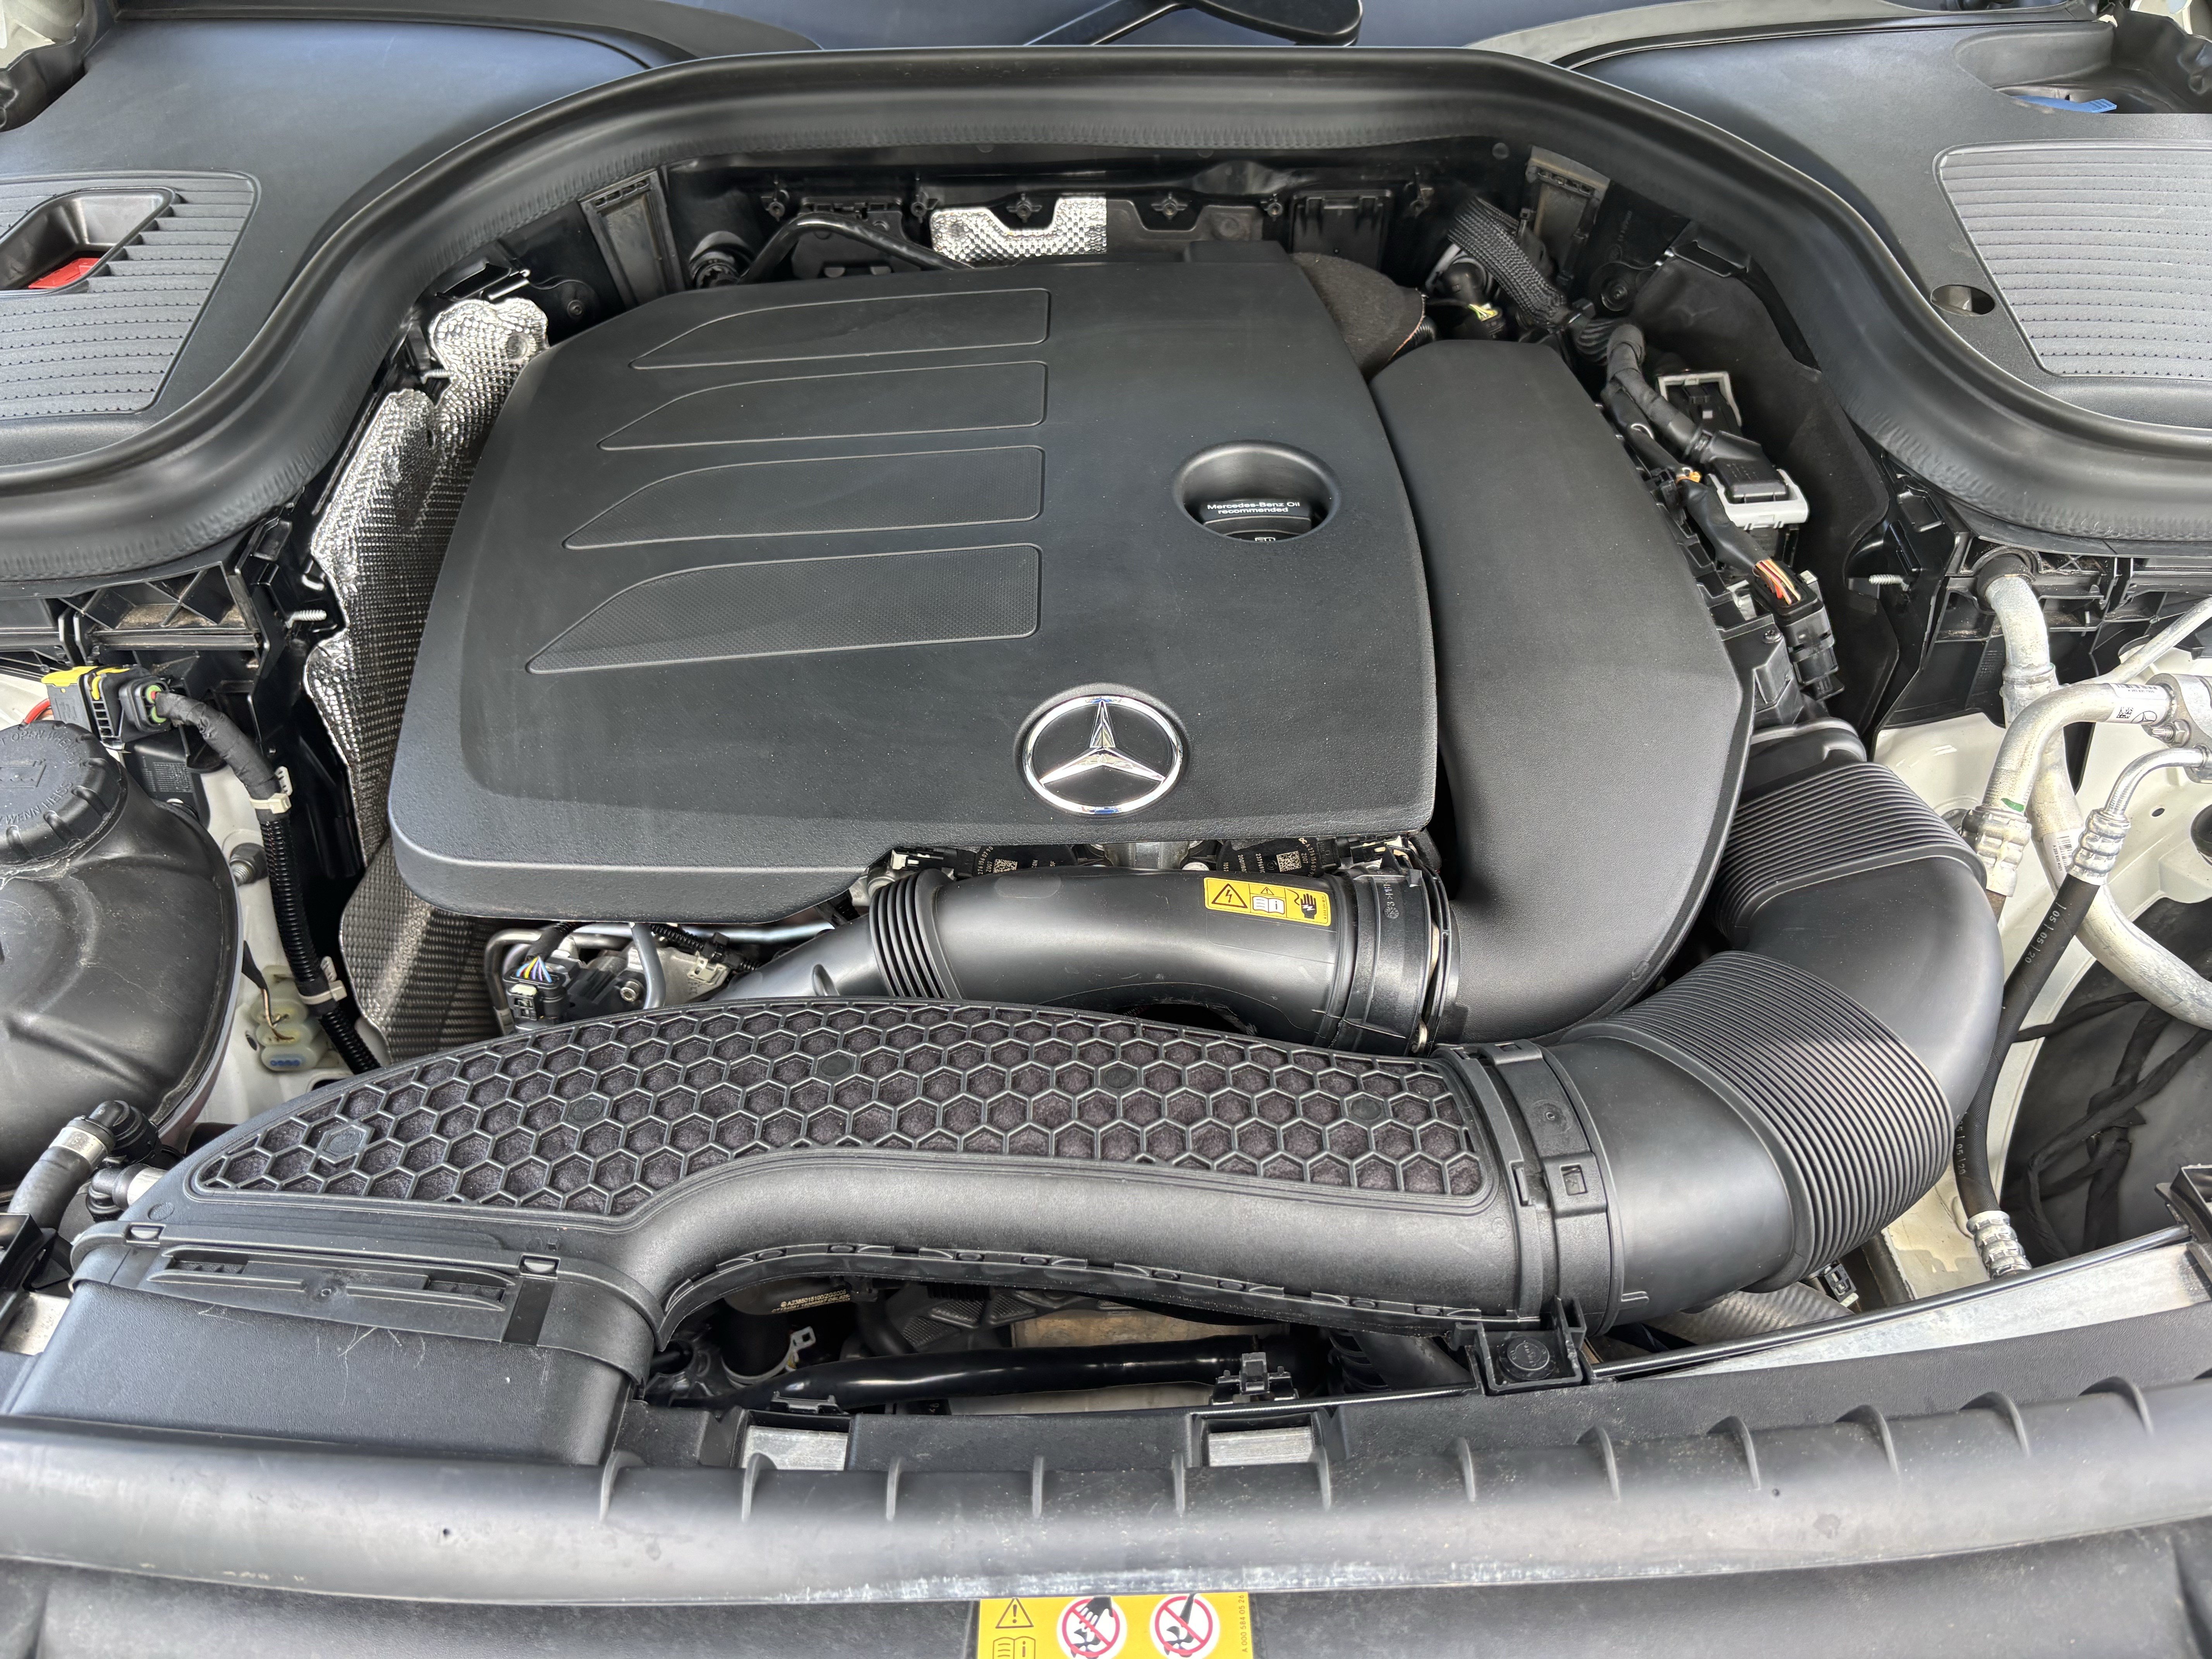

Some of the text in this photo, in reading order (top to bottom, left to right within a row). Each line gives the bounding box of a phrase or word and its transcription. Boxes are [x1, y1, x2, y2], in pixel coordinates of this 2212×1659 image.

[6, 782, 74, 824] WENN HEISS
[1238, 1595, 1244, 1603] 26
[1239, 1605, 1245, 1614] 05
